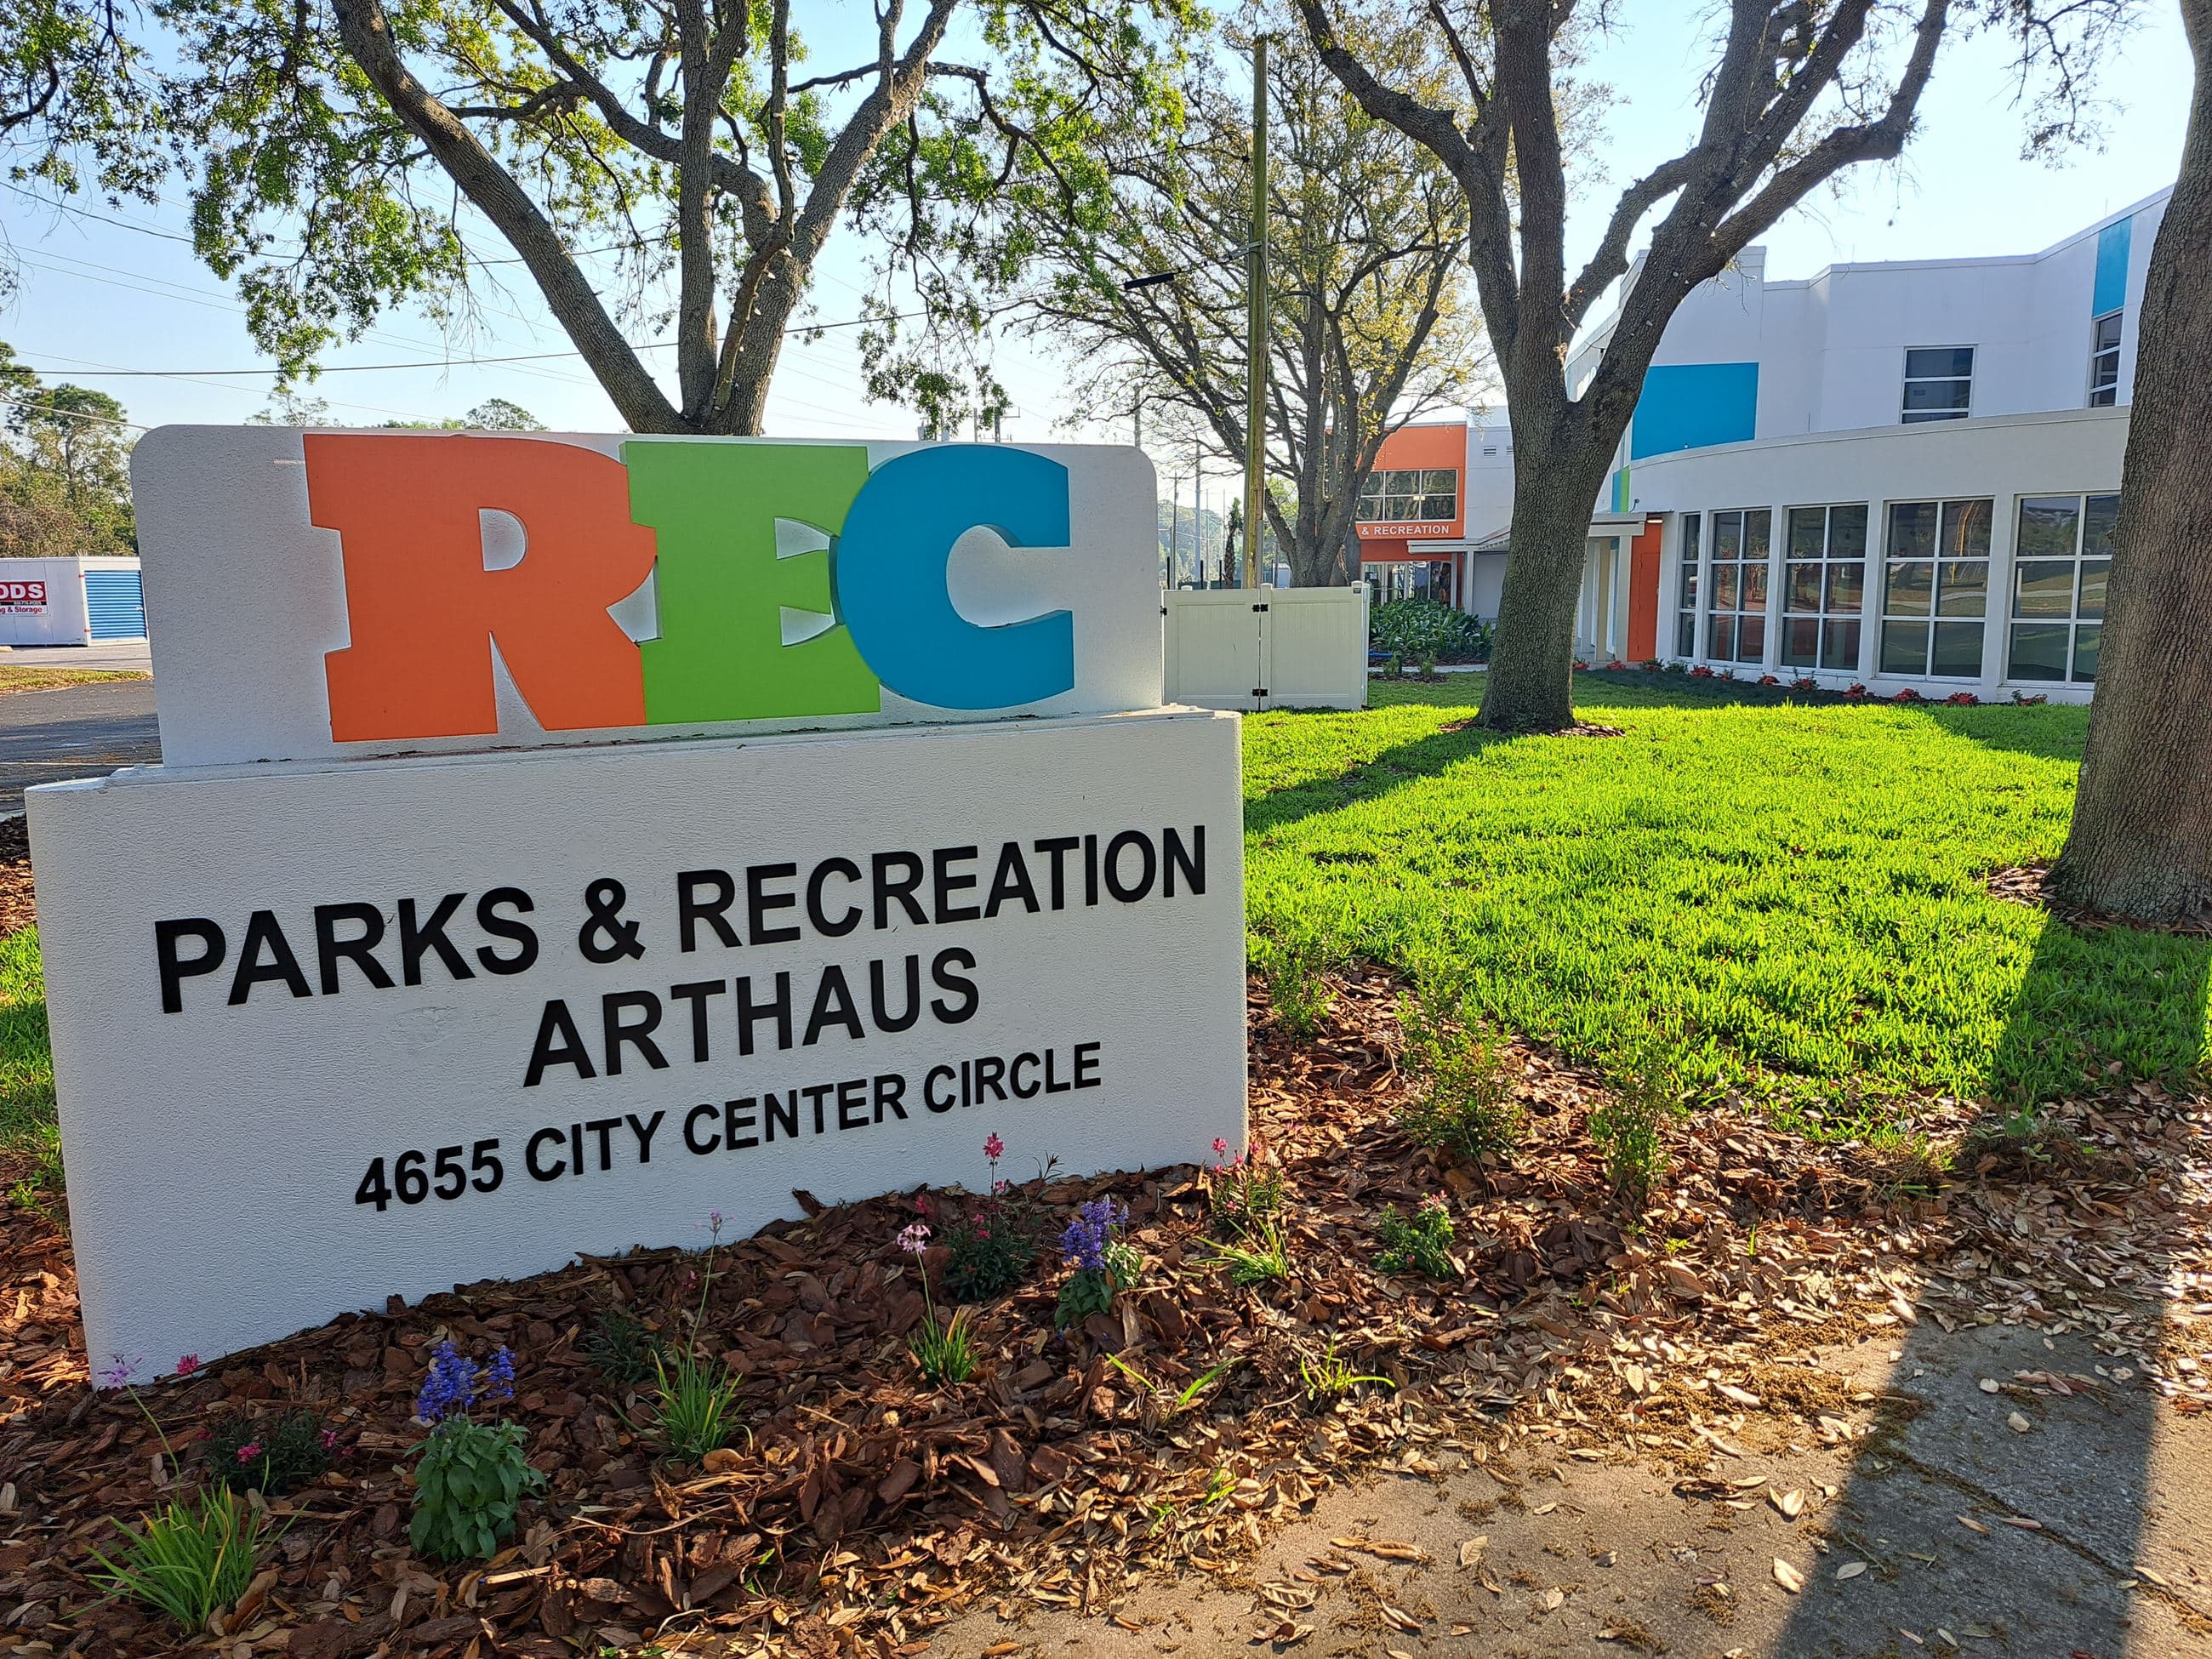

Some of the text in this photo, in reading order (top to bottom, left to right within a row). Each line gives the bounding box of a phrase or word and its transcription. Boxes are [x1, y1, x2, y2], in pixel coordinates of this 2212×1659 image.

[302, 432, 1075, 743] REC
[1361, 525, 1449, 535] & RECREATION
[155, 825, 1206, 1014] PARKS & RECREATION
[522, 947, 979, 1088] ARTHAUS
[355, 1041, 1102, 1212] 4655 CITY CENTER CIRCLE
